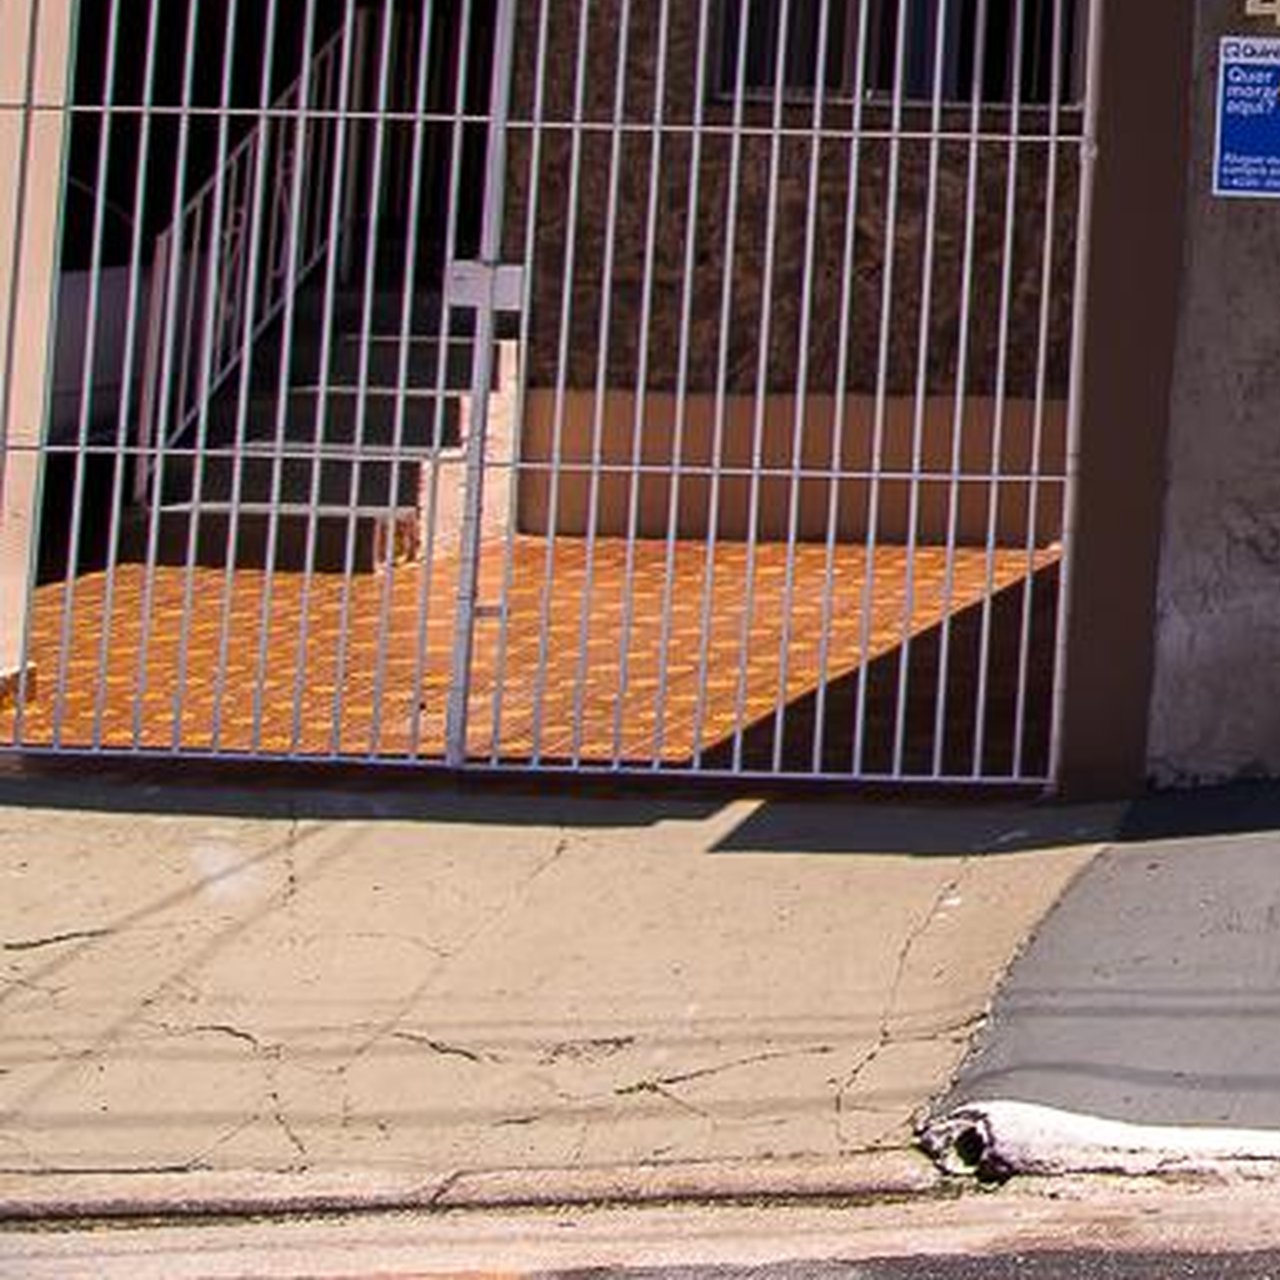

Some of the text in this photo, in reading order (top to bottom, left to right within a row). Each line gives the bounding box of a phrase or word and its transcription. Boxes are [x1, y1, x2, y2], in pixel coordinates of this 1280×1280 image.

[1227, 66, 1274, 84] Quer
[1226, 85, 1280, 99] morar
[1226, 99, 1276, 117] aqui?
